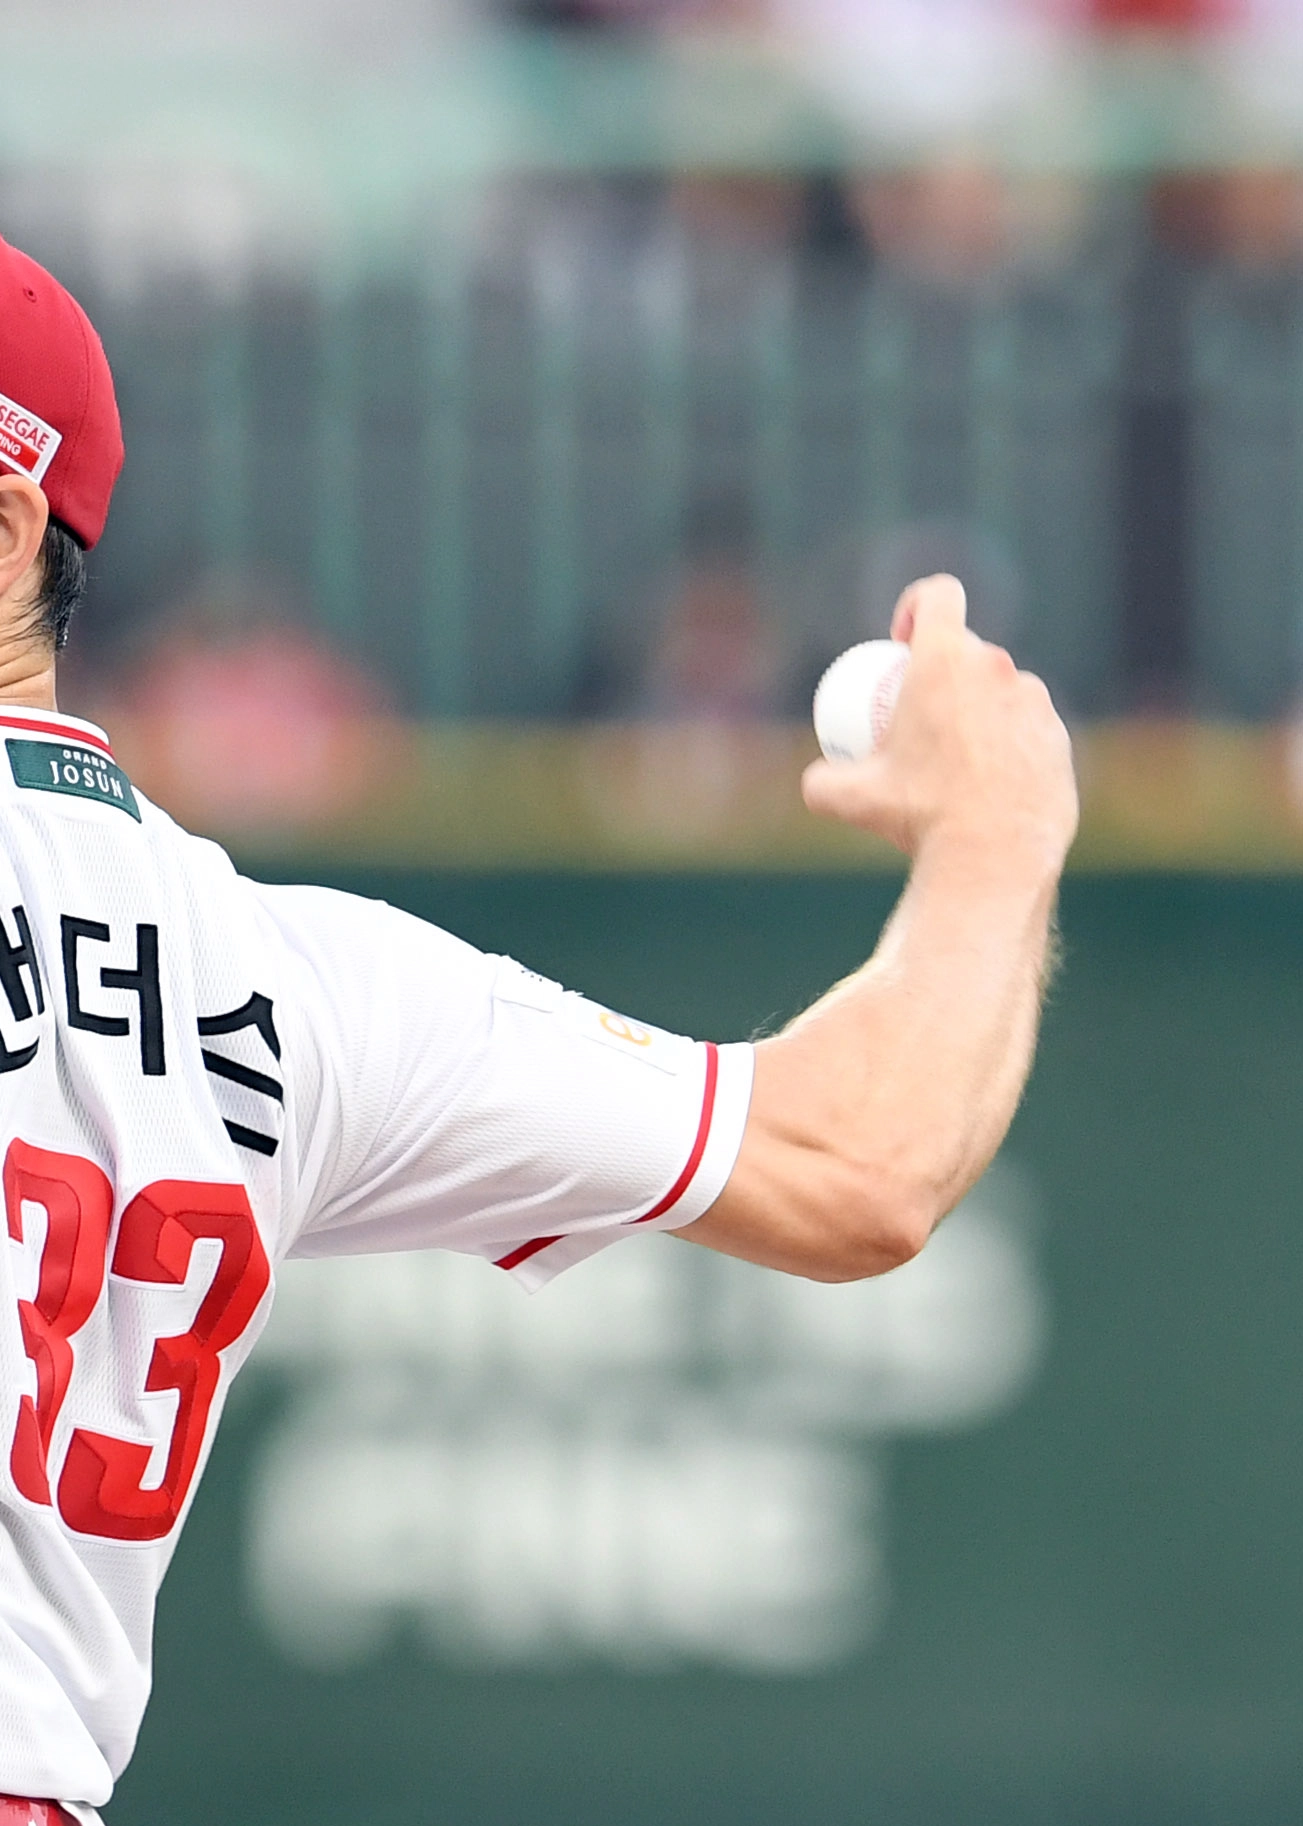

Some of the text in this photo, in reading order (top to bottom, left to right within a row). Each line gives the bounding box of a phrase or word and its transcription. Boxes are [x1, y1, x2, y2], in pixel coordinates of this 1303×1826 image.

[62, 749, 107, 770] GRAND
[49, 760, 124, 800] JOSUN
[2, 1136, 271, 1542] 33
